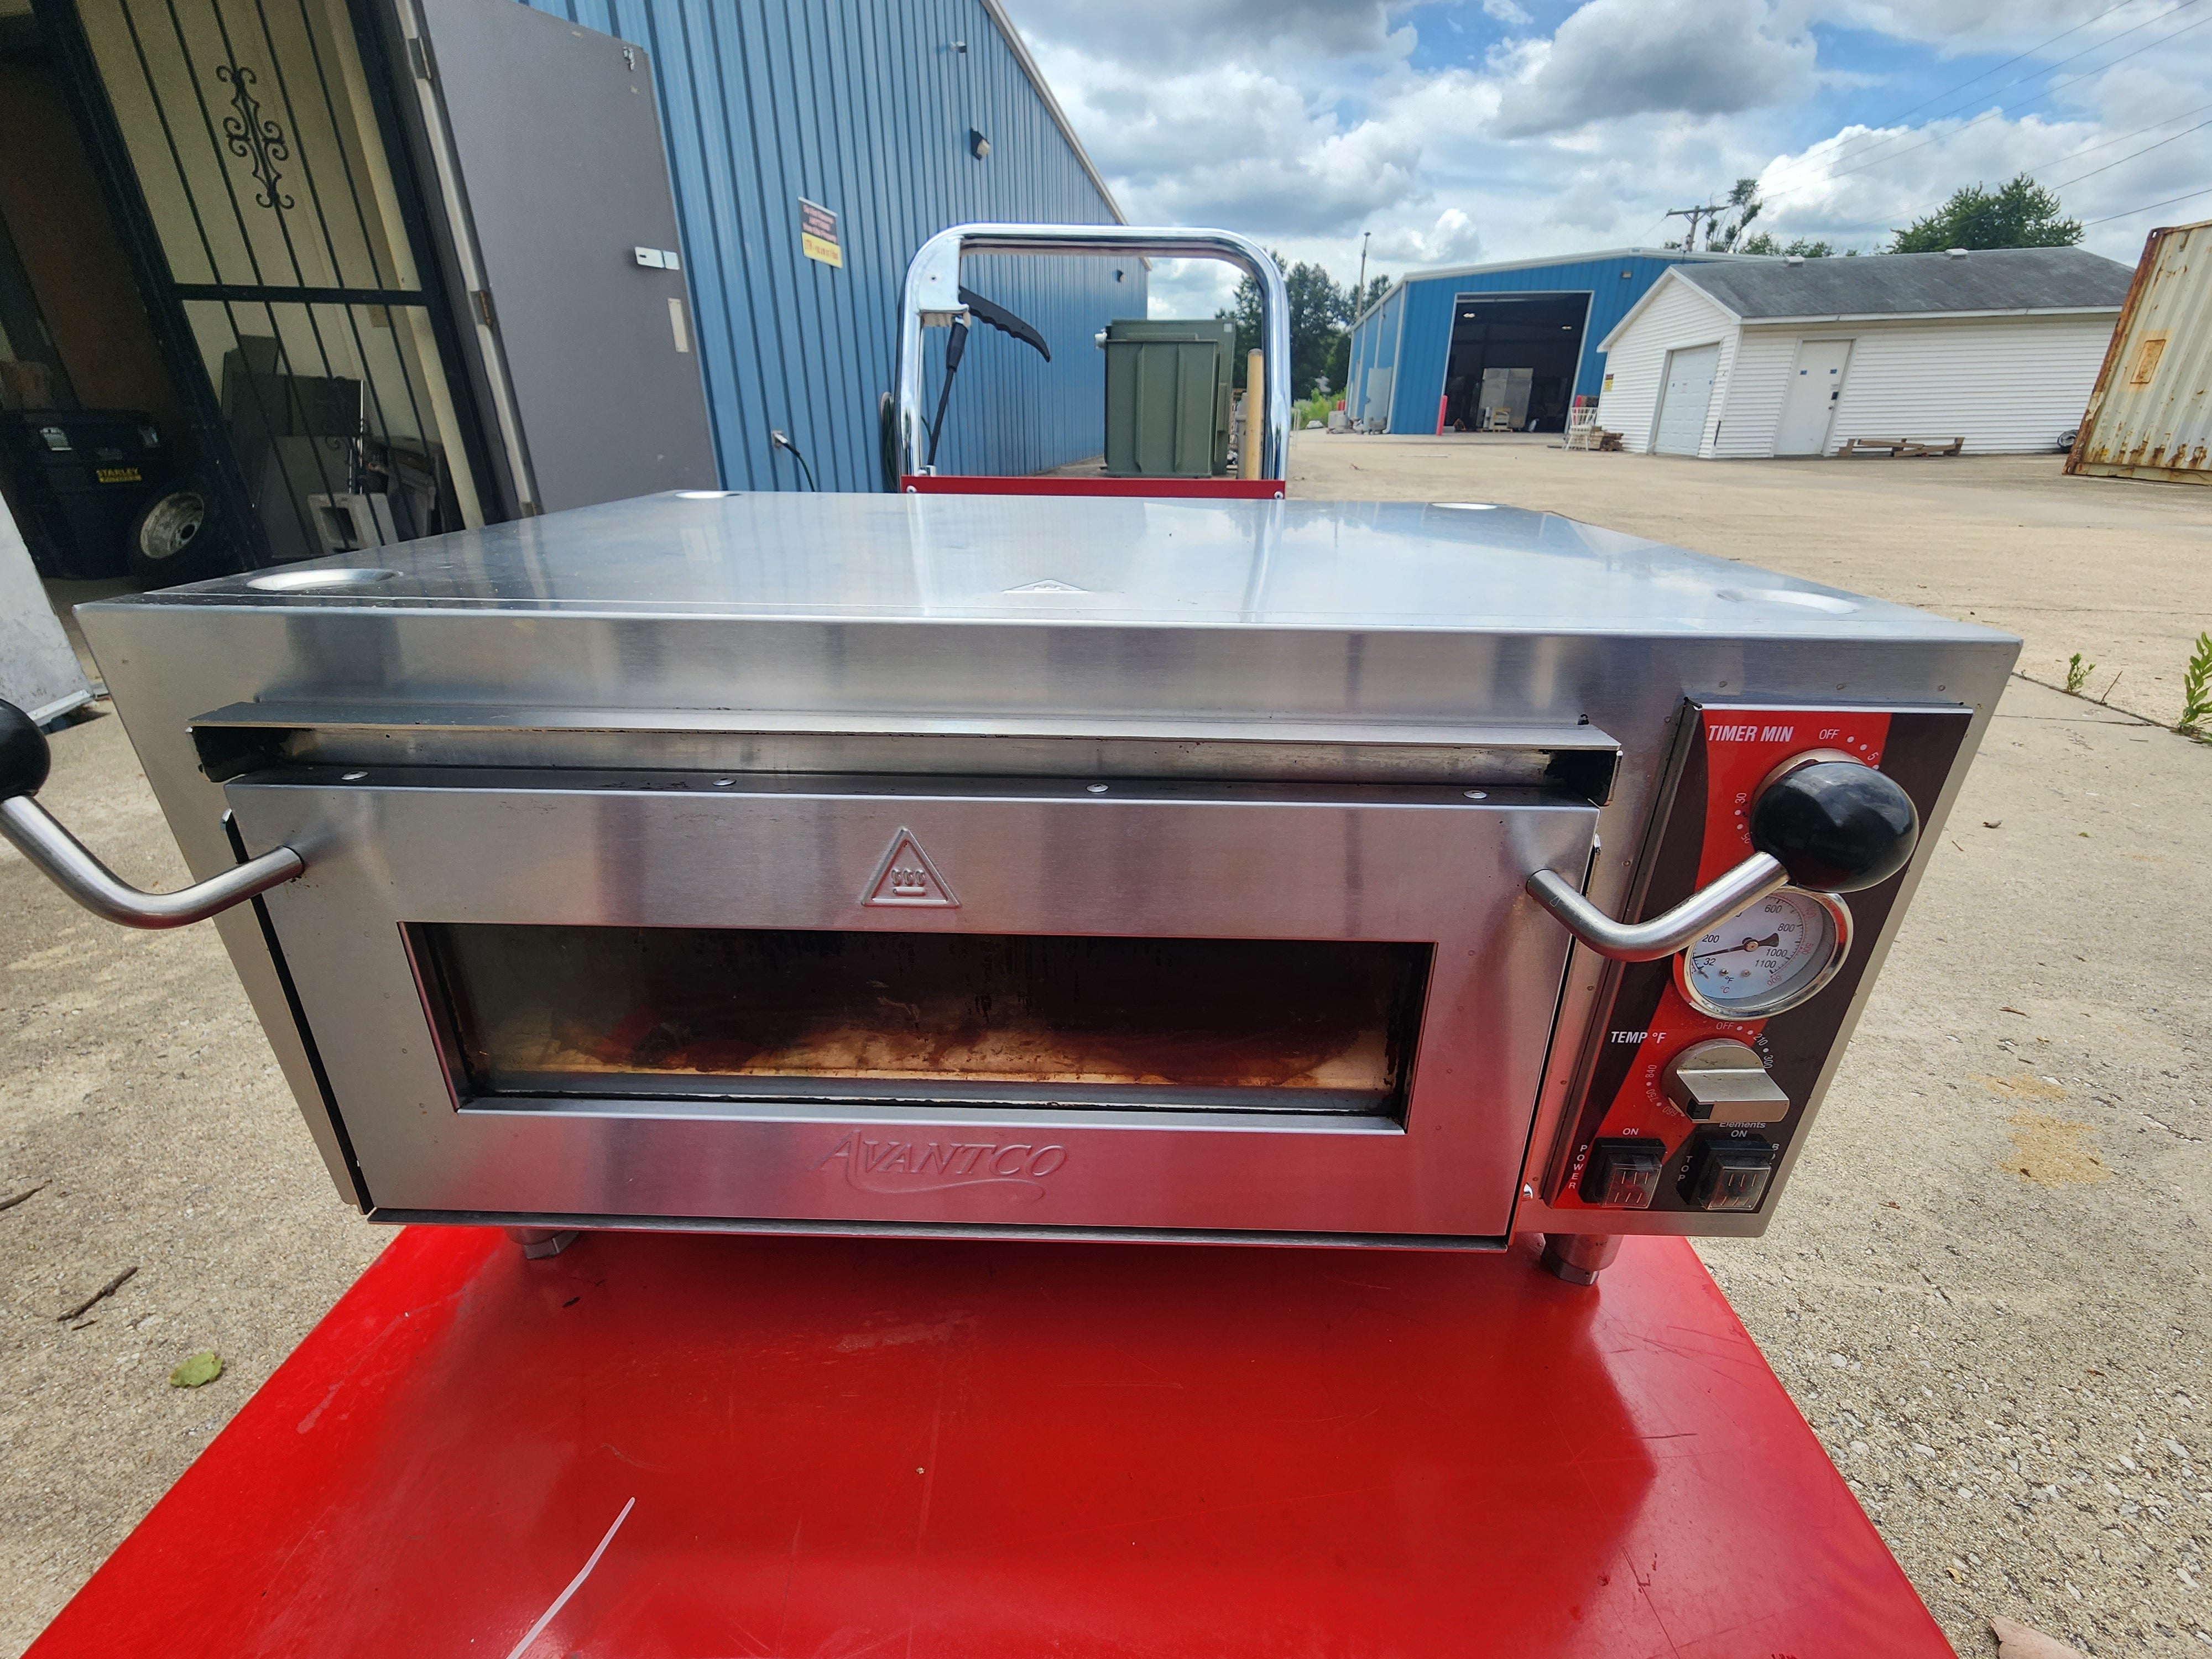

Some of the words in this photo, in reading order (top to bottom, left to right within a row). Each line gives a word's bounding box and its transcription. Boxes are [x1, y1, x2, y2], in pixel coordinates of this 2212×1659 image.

[1708, 725, 1757, 742] TIMER
[1760, 726, 1794, 742] MIN
[1819, 729, 1840, 740] OFF
[1867, 752, 1879, 761] 5
[1735, 792, 1747, 804] 30
[1764, 905, 1782, 914] 600
[1777, 923, 1795, 932] 800
[1702, 935, 1720, 943] 200
[1766, 948, 1788, 958] 1000
[1802, 942, 1813, 955] 500
[1703, 958, 1716, 966] 32
[1755, 959, 1777, 968] 1100
[1720, 985, 1730, 994] °C
[1716, 1021, 1735, 1030] OFF
[1611, 1031, 1648, 1044] TEMP
[1652, 1032, 1667, 1044] °F
[1753, 1033, 1768, 1046] 210
[1763, 1055, 1773, 1069] 300
[1645, 1065, 1657, 1078] 840
[1646, 1088, 1659, 1102] 750
[1568, 1144, 1588, 1189] POWER
[1677, 1155, 1693, 1181] TOP
